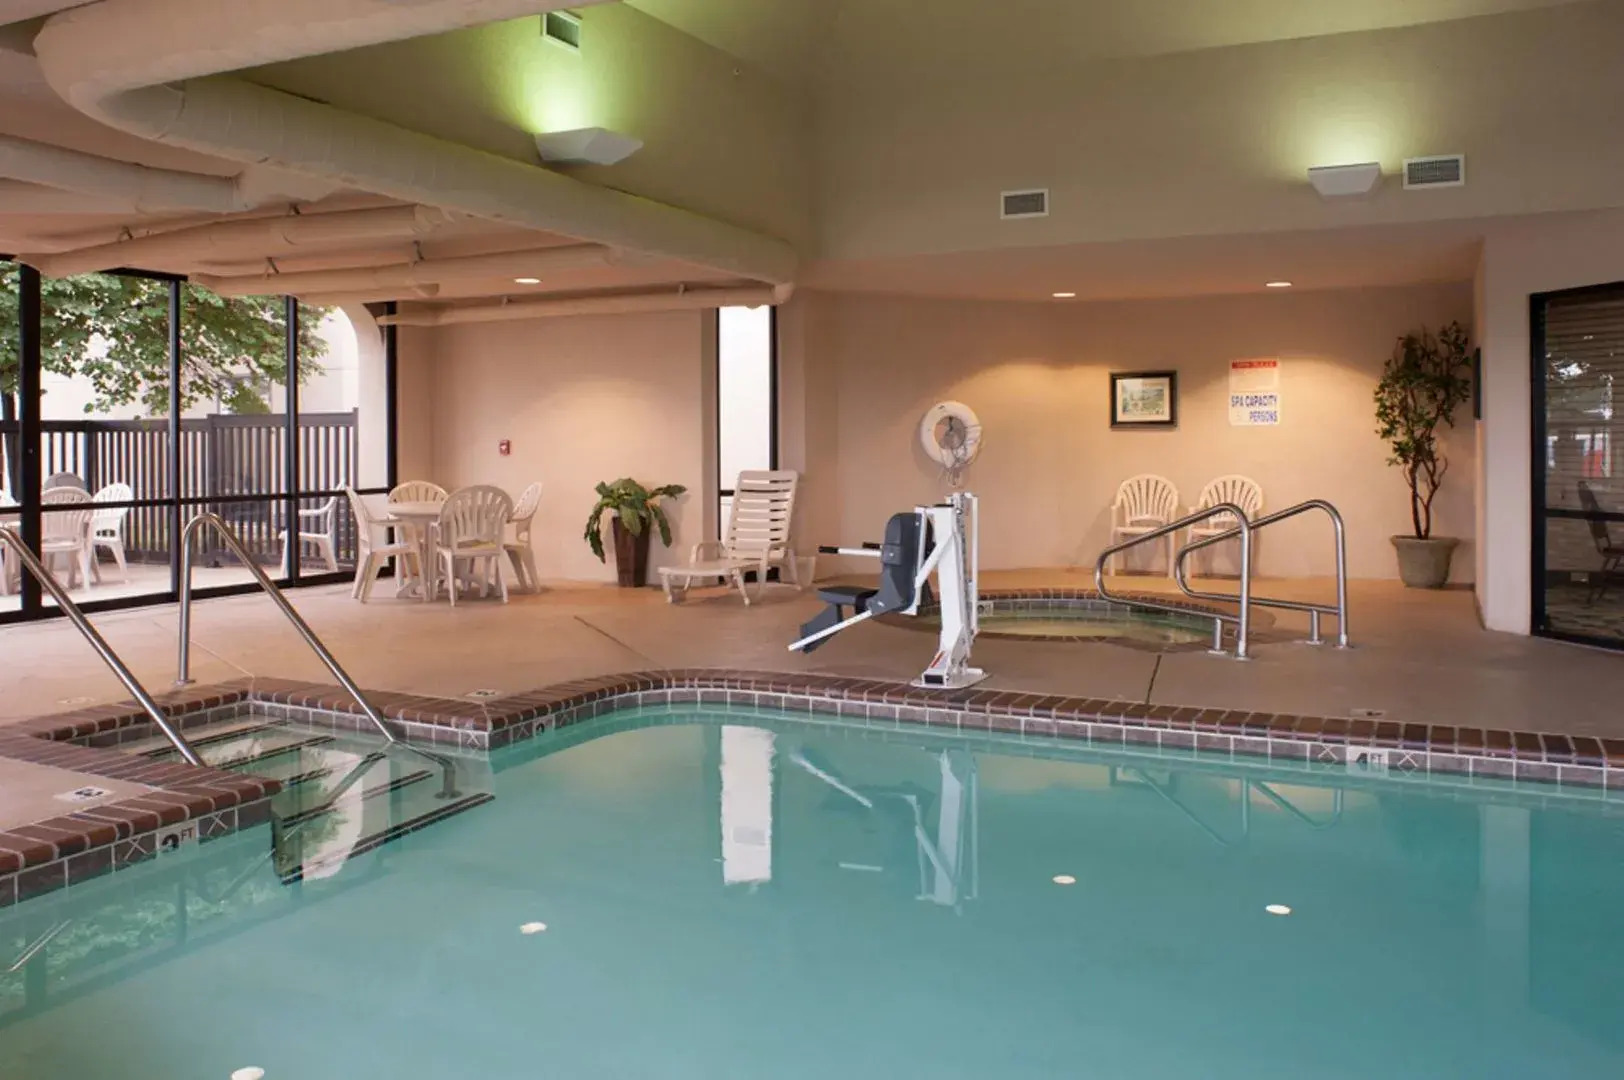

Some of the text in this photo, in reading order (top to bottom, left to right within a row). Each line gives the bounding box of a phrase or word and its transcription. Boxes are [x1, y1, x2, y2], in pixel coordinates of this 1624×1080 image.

[1231, 395, 1277, 408] SPA CAPACITY
[1249, 410, 1277, 422] PERSONS
[180, 827, 193, 841] FT
